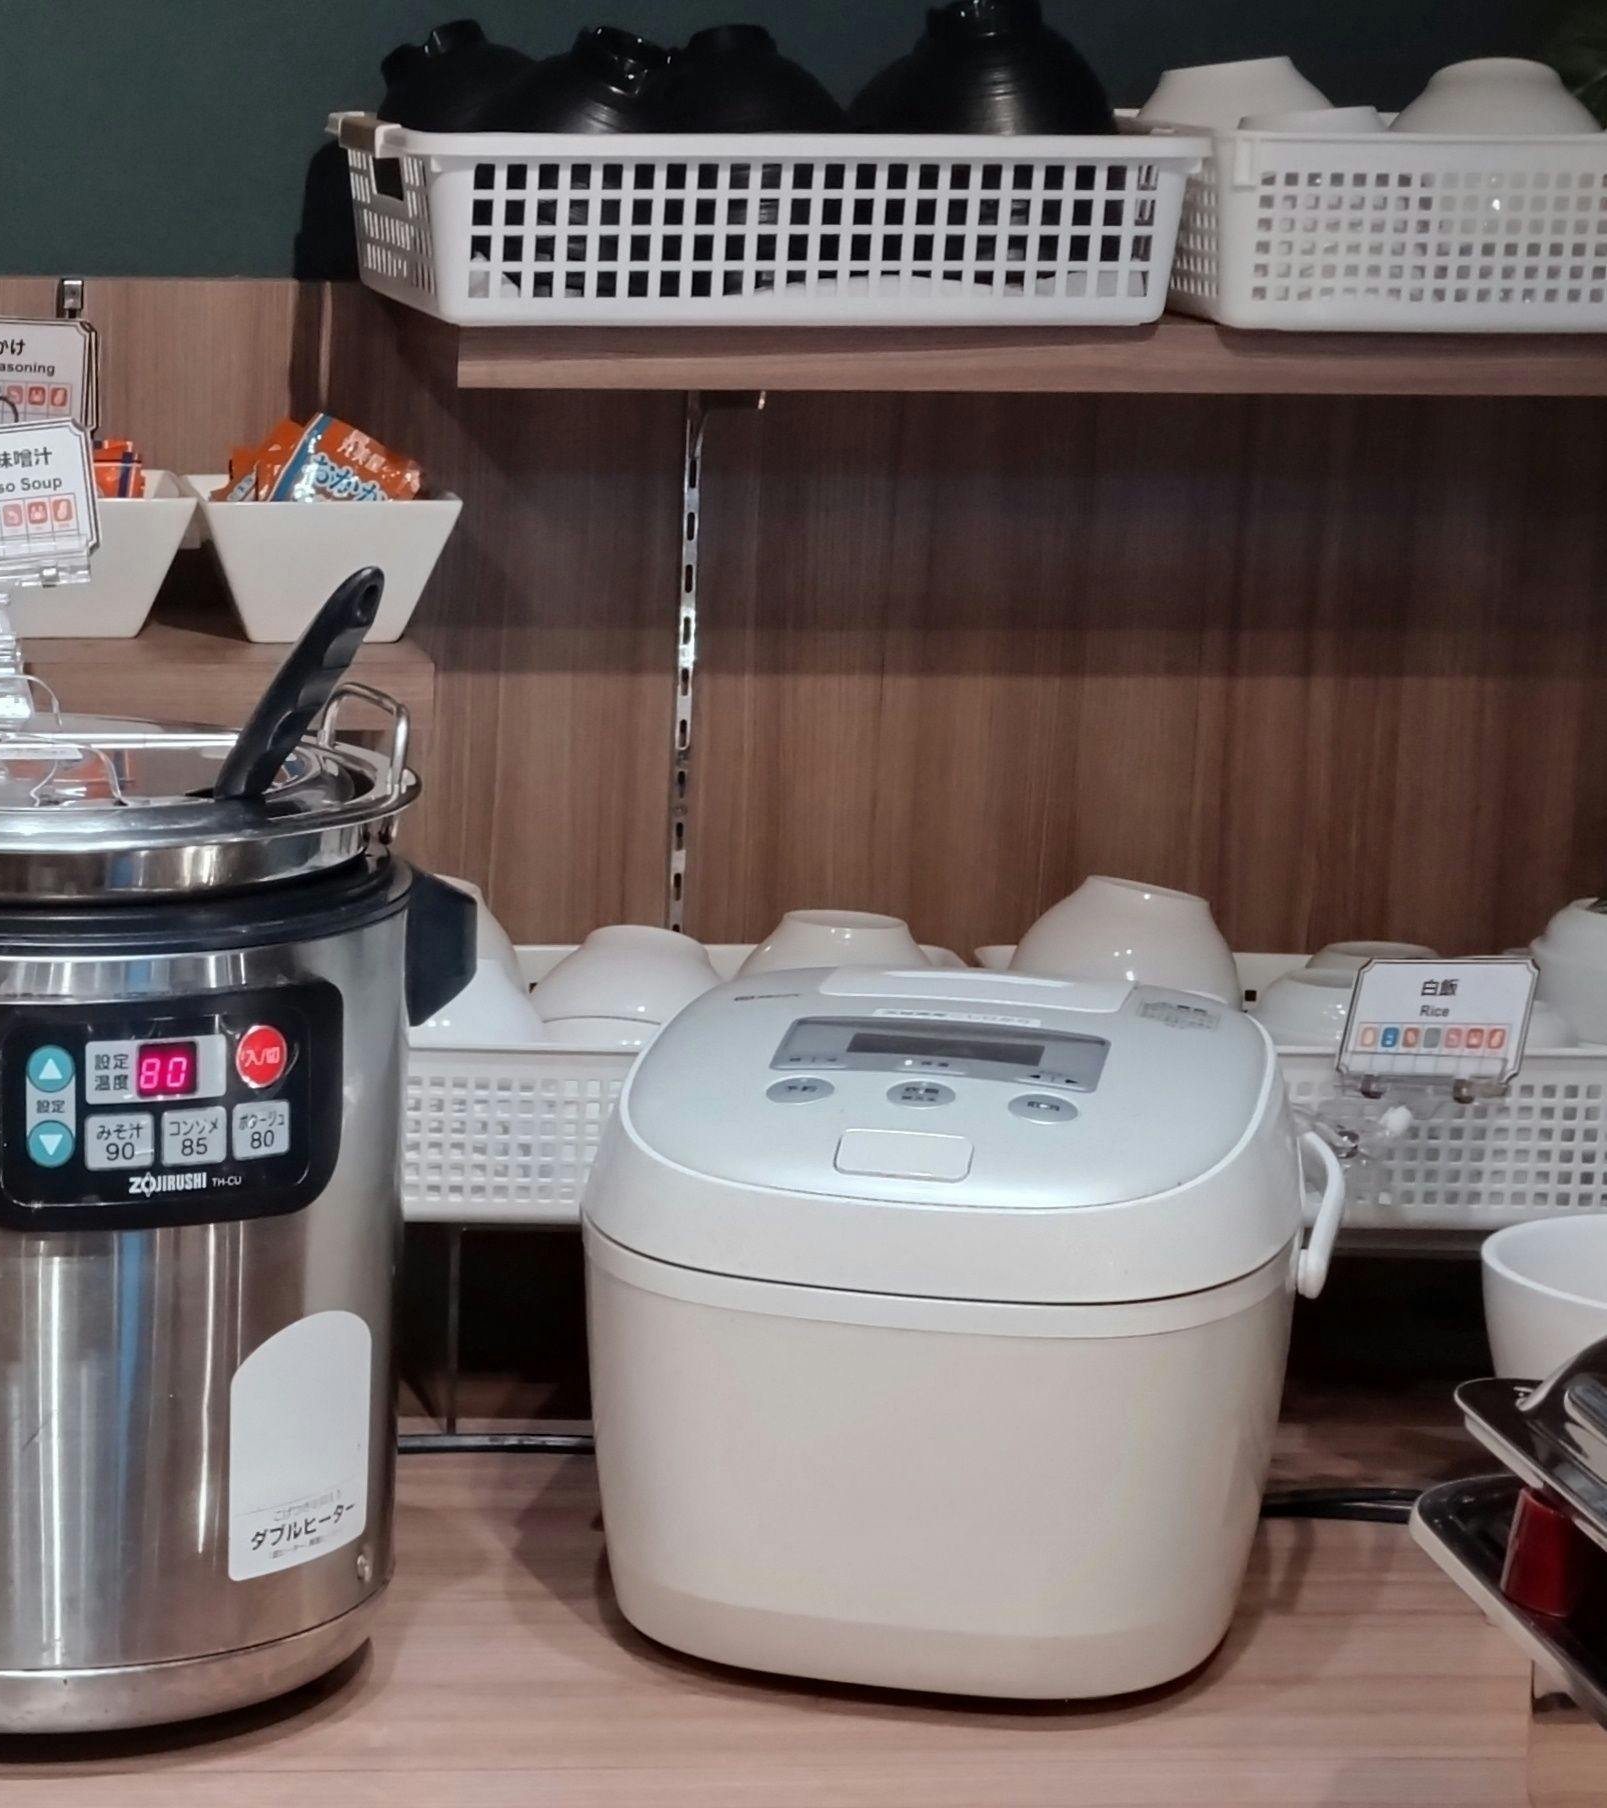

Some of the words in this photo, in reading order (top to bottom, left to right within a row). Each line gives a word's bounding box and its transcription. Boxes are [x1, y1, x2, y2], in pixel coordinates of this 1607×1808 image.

[20, 477, 63, 493] Soup
[1421, 978, 1459, 996] 白飯
[1420, 1005, 1450, 1017] Rice
[95, 1053, 130, 1070] 設定
[140, 1057, 188, 1089] 80
[95, 1074, 129, 1092] 温度
[36, 1100, 66, 1114] 設定
[96, 1123, 144, 1141] みそ汁
[168, 1118, 220, 1137] コンソメ
[181, 1137, 208, 1157] 85
[250, 1130, 275, 1150] 80
[106, 1142, 135, 1162] 90
[128, 1171, 208, 1198] ZOJIRUSHI
[212, 1176, 243, 1188] TH-CU
[251, 1503, 355, 1551] ダブルヒーター
